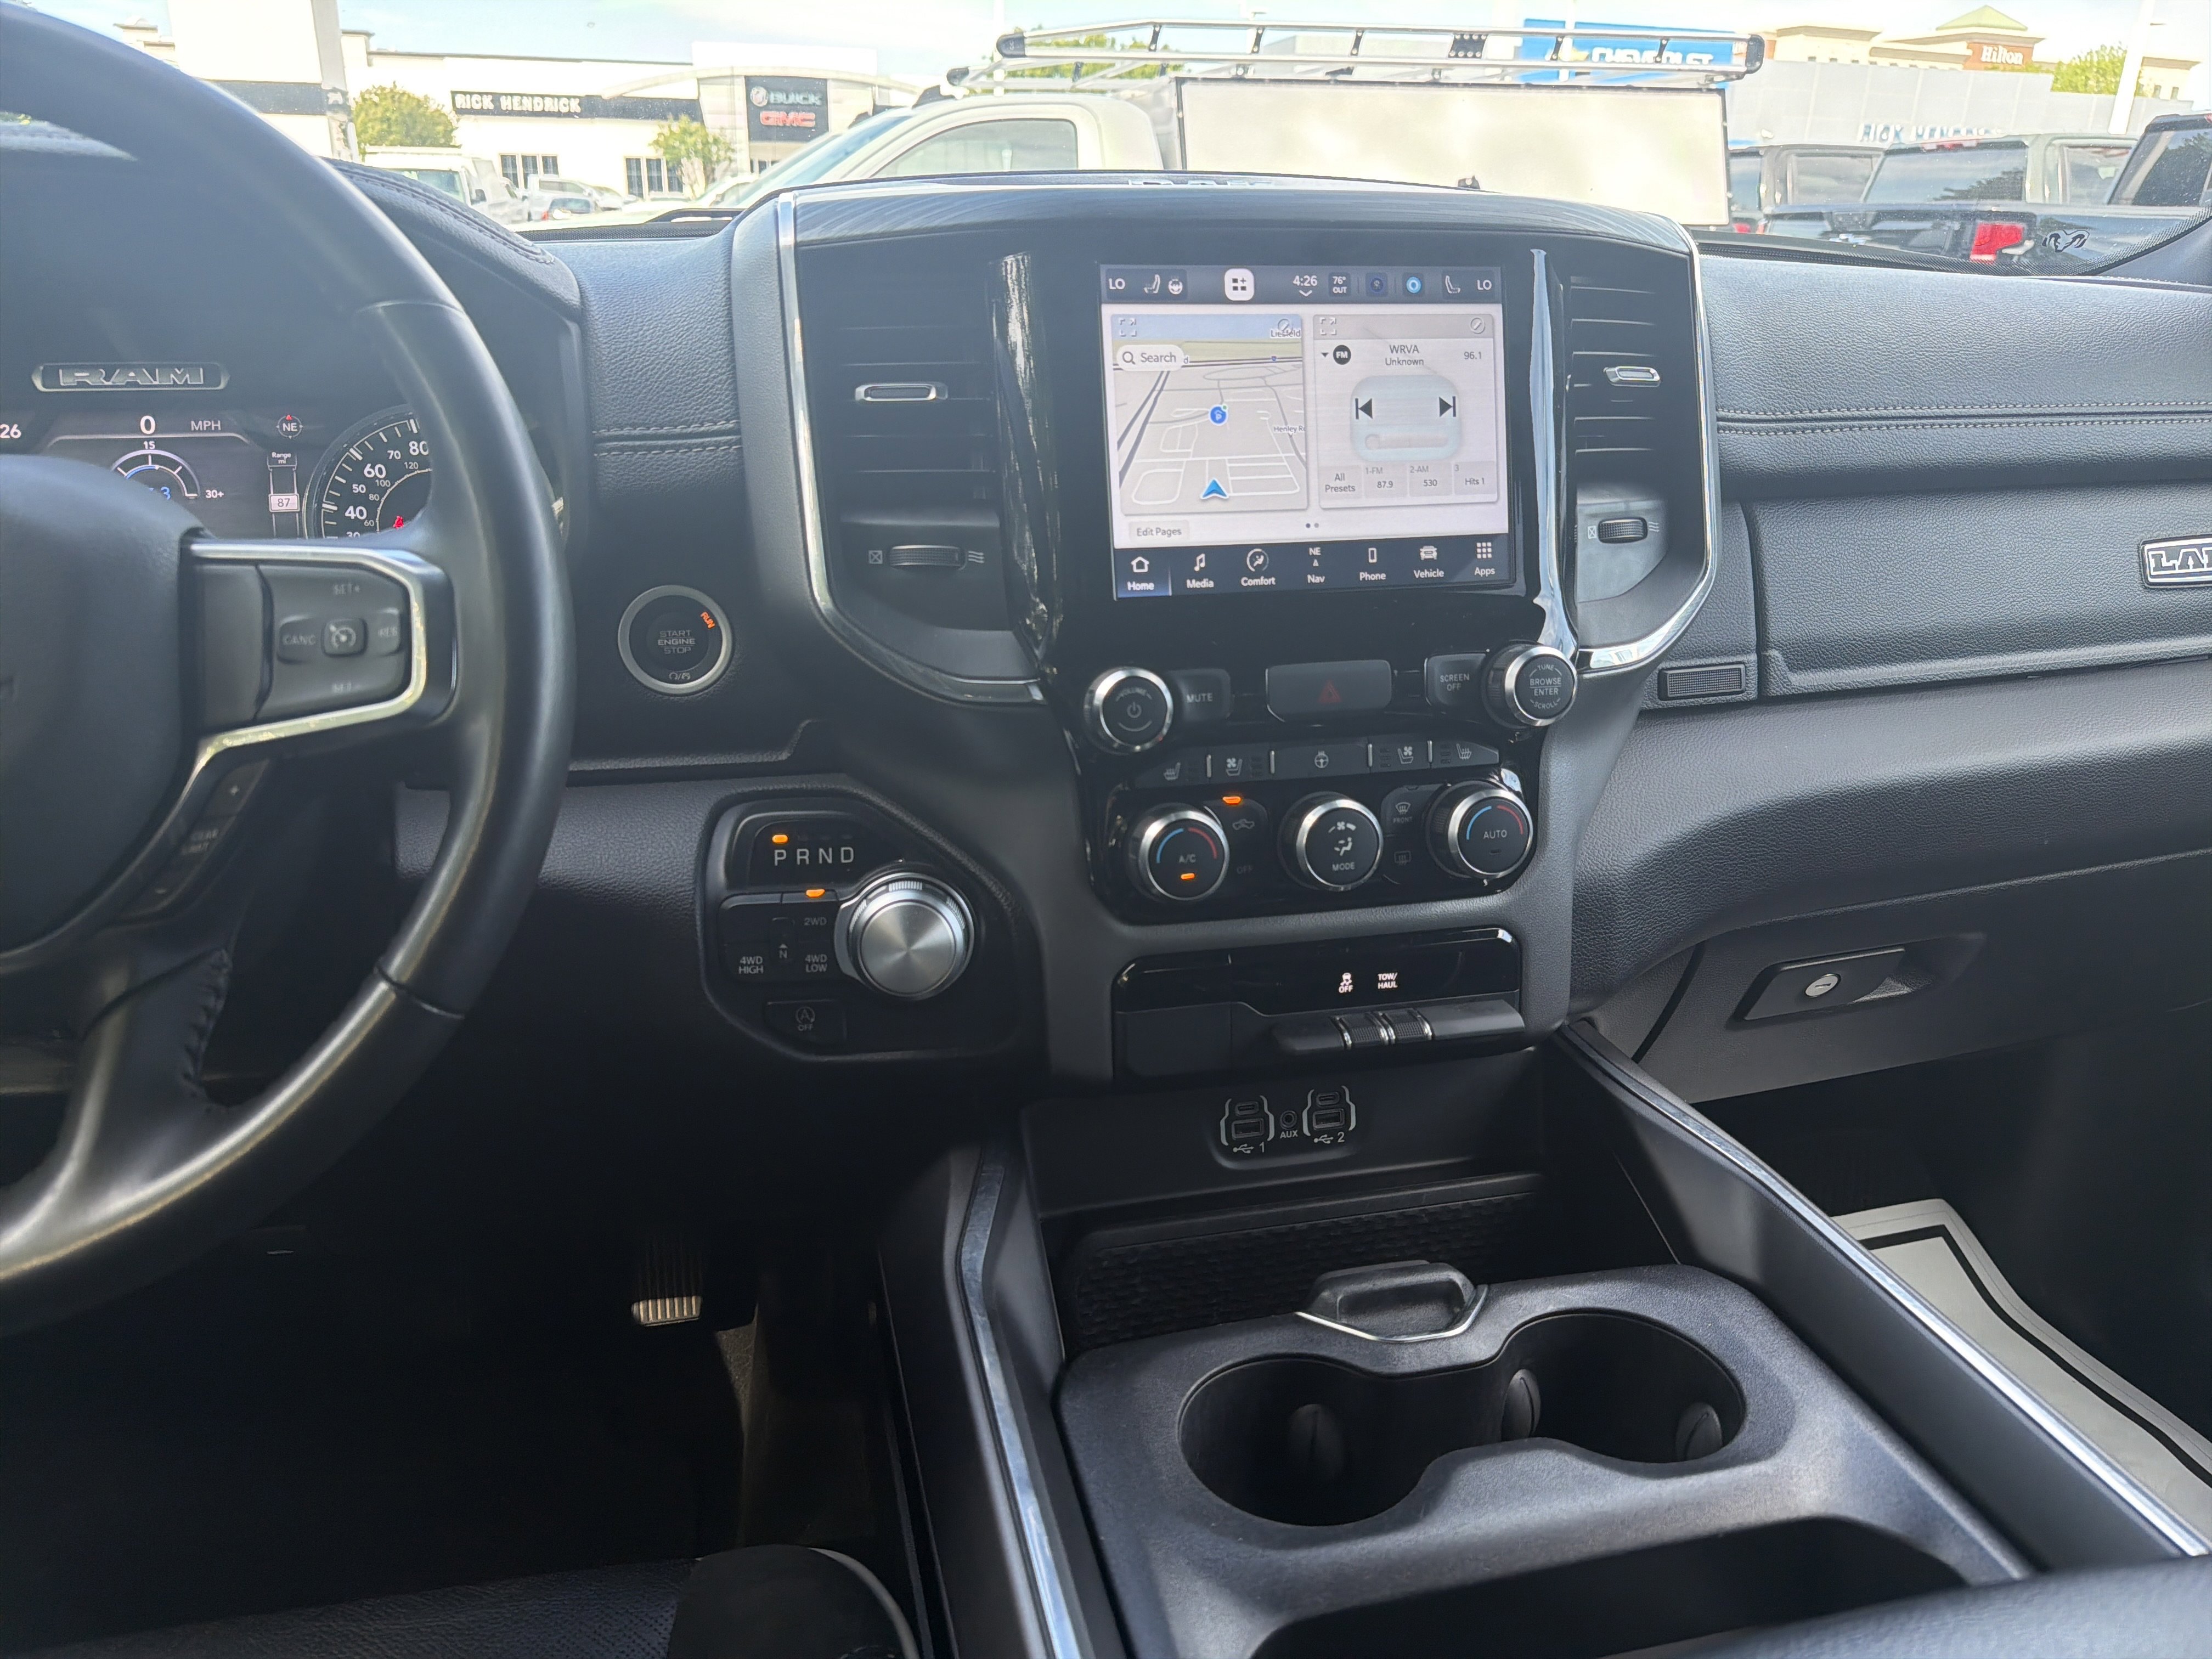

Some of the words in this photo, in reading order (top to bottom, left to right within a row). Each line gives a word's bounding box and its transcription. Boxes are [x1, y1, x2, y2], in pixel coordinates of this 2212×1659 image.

[1981, 45, 2023, 65] Hilton
[769, 91, 822, 105] BUICK
[455, 94, 494, 109] RICK
[500, 95, 581, 112] HENDRICK
[760, 111, 816, 127] GMC
[1108, 278, 1125, 290] LO
[1293, 275, 1317, 286] 4:26
[1332, 276, 1346, 285] 76°
[1477, 279, 1492, 290] LO
[1389, 345, 1419, 354] WRVA
[1141, 353, 1176, 363] Search
[1464, 352, 1482, 360] 96.1
[1385, 358, 1424, 366] Unknown
[59, 368, 204, 386] RAM
[140, 415, 156, 435] 0
[190, 420, 222, 431] MPH
[283, 423, 297, 432] NE
[143, 441, 155, 449] 15
[409, 441, 429, 455] 80
[272, 452, 291, 460] Range
[387, 450, 401, 460] 70
[364, 464, 386, 478] 60
[1334, 473, 1345, 481] All
[352, 484, 366, 493] 50
[205, 489, 224, 499] 30+
[277, 498, 289, 507] 87
[345, 506, 367, 520] 40
[1137, 528, 1154, 537] Edit
[1155, 528, 1182, 538] Pages
[1359, 572, 1386, 581] Phone
[1413, 569, 1444, 578] Vehicle
[1475, 567, 1496, 577] Apps
[1187, 578, 1214, 589] Media
[1241, 576, 1276, 586] Comfort
[1307, 575, 1325, 583] Nav
[1127, 582, 1155, 591] Home
[700, 612, 715, 629] RUN
[1440, 674, 1470, 682] SCREEN
[1530, 678, 1561, 686] BROWSE
[1447, 683, 1462, 691] OFF
[1186, 693, 1213, 703] MUTE
[1534, 701, 1558, 709] SCROLL
[1483, 830, 1508, 839] AUTO
[1178, 854, 1197, 864] A/C
[1237, 864, 1253, 873] OFF
[1333, 861, 1356, 871] MODE
[804, 917, 827, 926] 2WD
[779, 950, 787, 958] N
[805, 954, 827, 962] 4WD
[740, 956, 763, 964] 4WD
[738, 966, 764, 974] HIGH
[805, 964, 828, 973] LOW
[1378, 972, 1398, 981] TOW/
[1280, 1130, 1298, 1139] AUX
[1338, 1131, 1345, 1143] 2
[1260, 1142, 1265, 1153] 1
